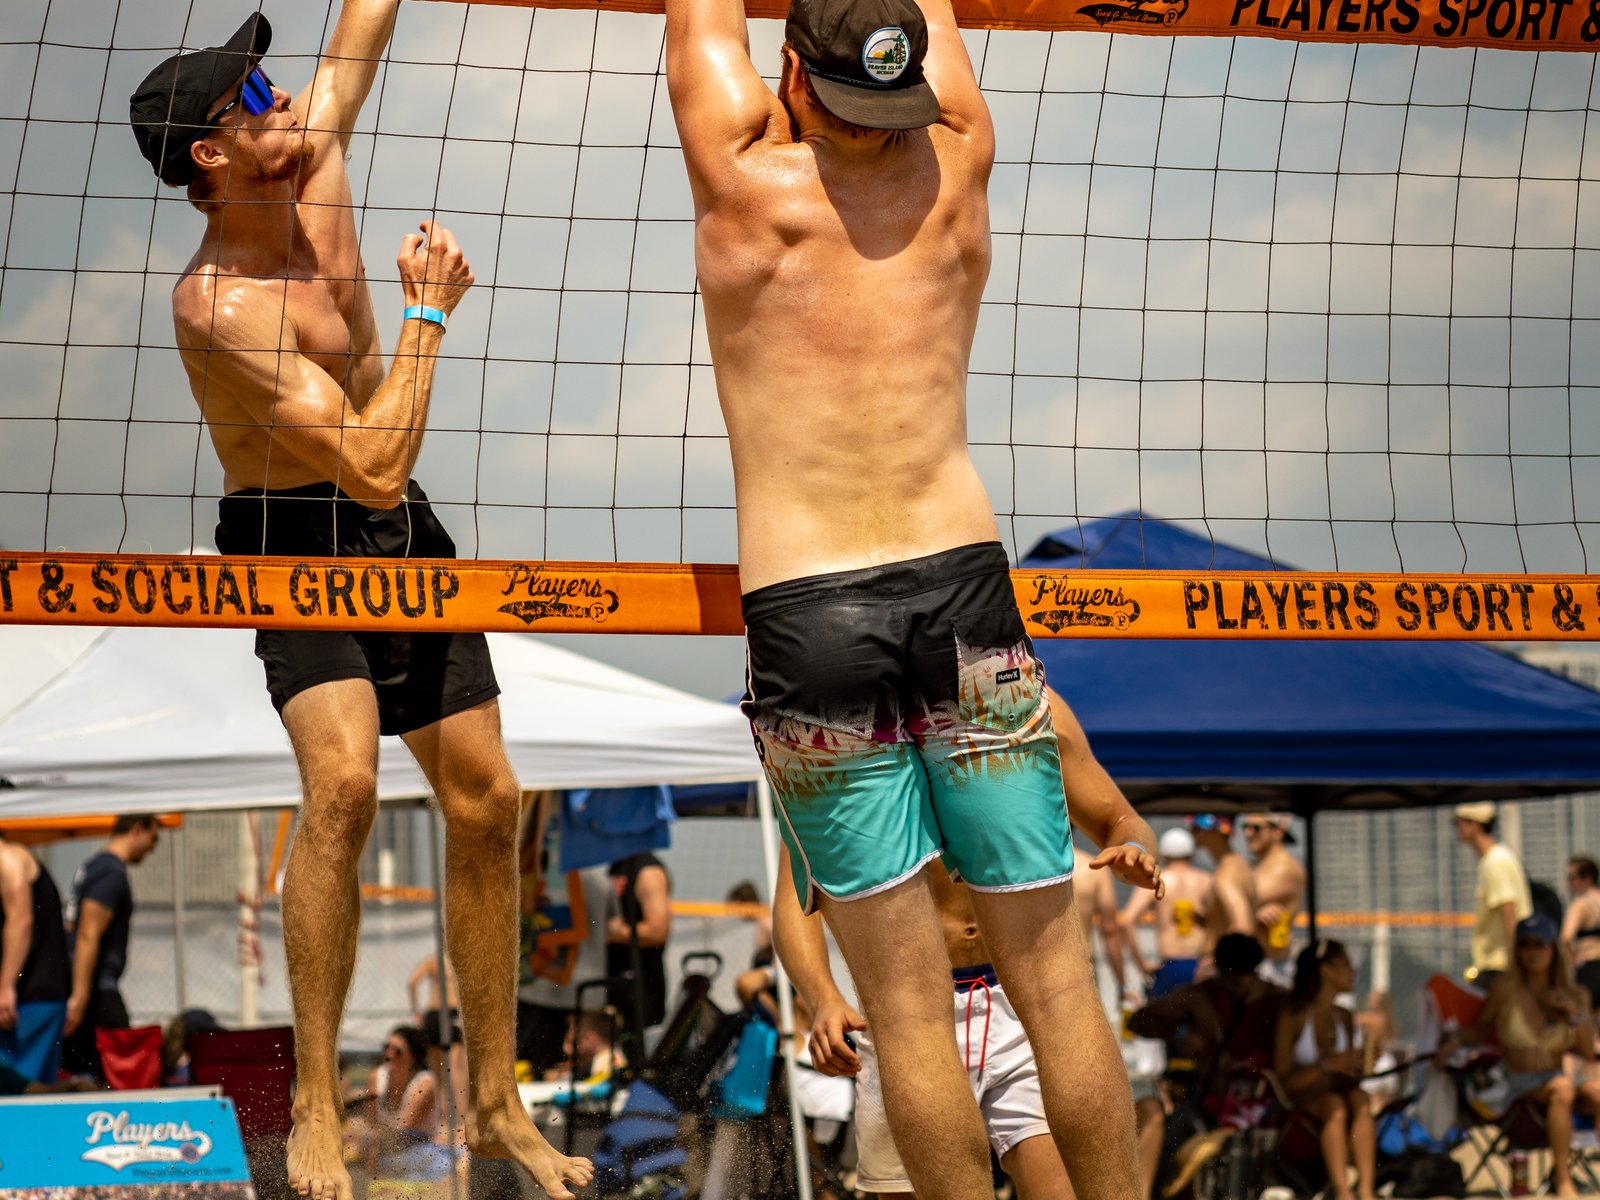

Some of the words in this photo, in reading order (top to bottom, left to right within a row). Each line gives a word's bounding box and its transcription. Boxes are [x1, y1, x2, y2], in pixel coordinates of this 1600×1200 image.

[37, 559, 77, 613] &
[91, 560, 274, 615] SOCIAL
[289, 563, 459, 618] GROUP
[502, 563, 603, 605] Players
[1029, 574, 1126, 614] Players
[1183, 580, 1379, 631] PLAYERS
[1394, 583, 1535, 632] SPORT
[1552, 583, 1585, 632] &
[85, 1111, 195, 1150] Players
